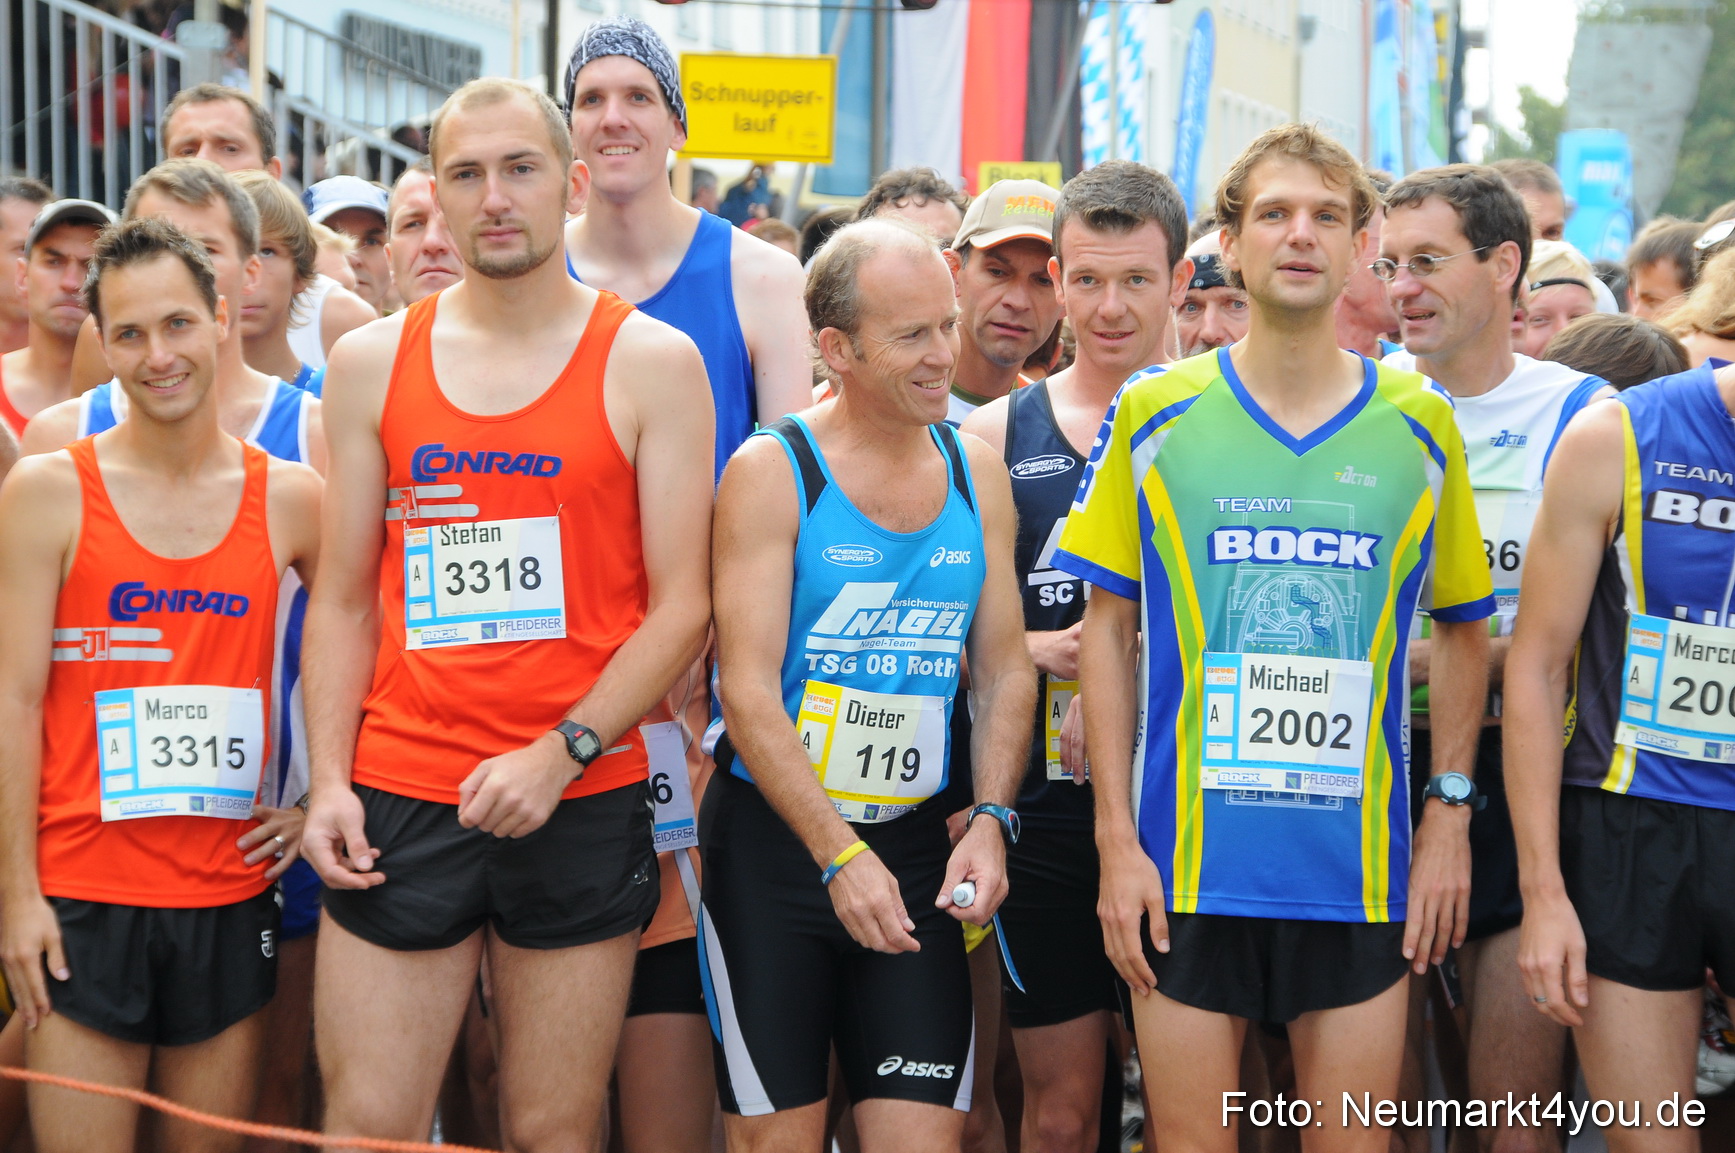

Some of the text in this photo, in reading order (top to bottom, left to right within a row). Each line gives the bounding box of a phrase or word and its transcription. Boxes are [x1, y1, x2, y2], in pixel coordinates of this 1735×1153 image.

[689, 81, 824, 108] Schnupper-
[733, 112, 777, 132] lauf
[1655, 461, 1733, 485] TEAM
[1213, 498, 1292, 513] TEAM
[440, 523, 501, 546] Stefan
[946, 551, 971, 564] asics
[1210, 528, 1379, 569] BOCK
[413, 564, 421, 581] A
[445, 556, 542, 596] 3318
[1039, 583, 1074, 607] SC
[500, 618, 562, 632] PFLEIDERER
[843, 609, 966, 637] NAGEL
[421, 628, 458, 641] BOCK
[859, 639, 916, 648] Nagel-Team
[805, 654, 957, 678] TSG 08 Roth
[1630, 665, 1640, 684] A
[1249, 665, 1329, 694] Michael
[145, 698, 207, 720] Marco
[845, 699, 905, 729] Dieter
[1052, 701, 1061, 718] A
[1209, 704, 1219, 722] A
[1249, 708, 1352, 750] 2002
[110, 738, 119, 755] A
[803, 731, 811, 750] A
[151, 735, 245, 770] 3315
[856, 744, 921, 783] 119
[1217, 772, 1260, 783] BOCK
[1303, 773, 1360, 788] PFLEIDERER
[206, 796, 251, 811] PFLEIDERER
[901, 1061, 955, 1079] asics
